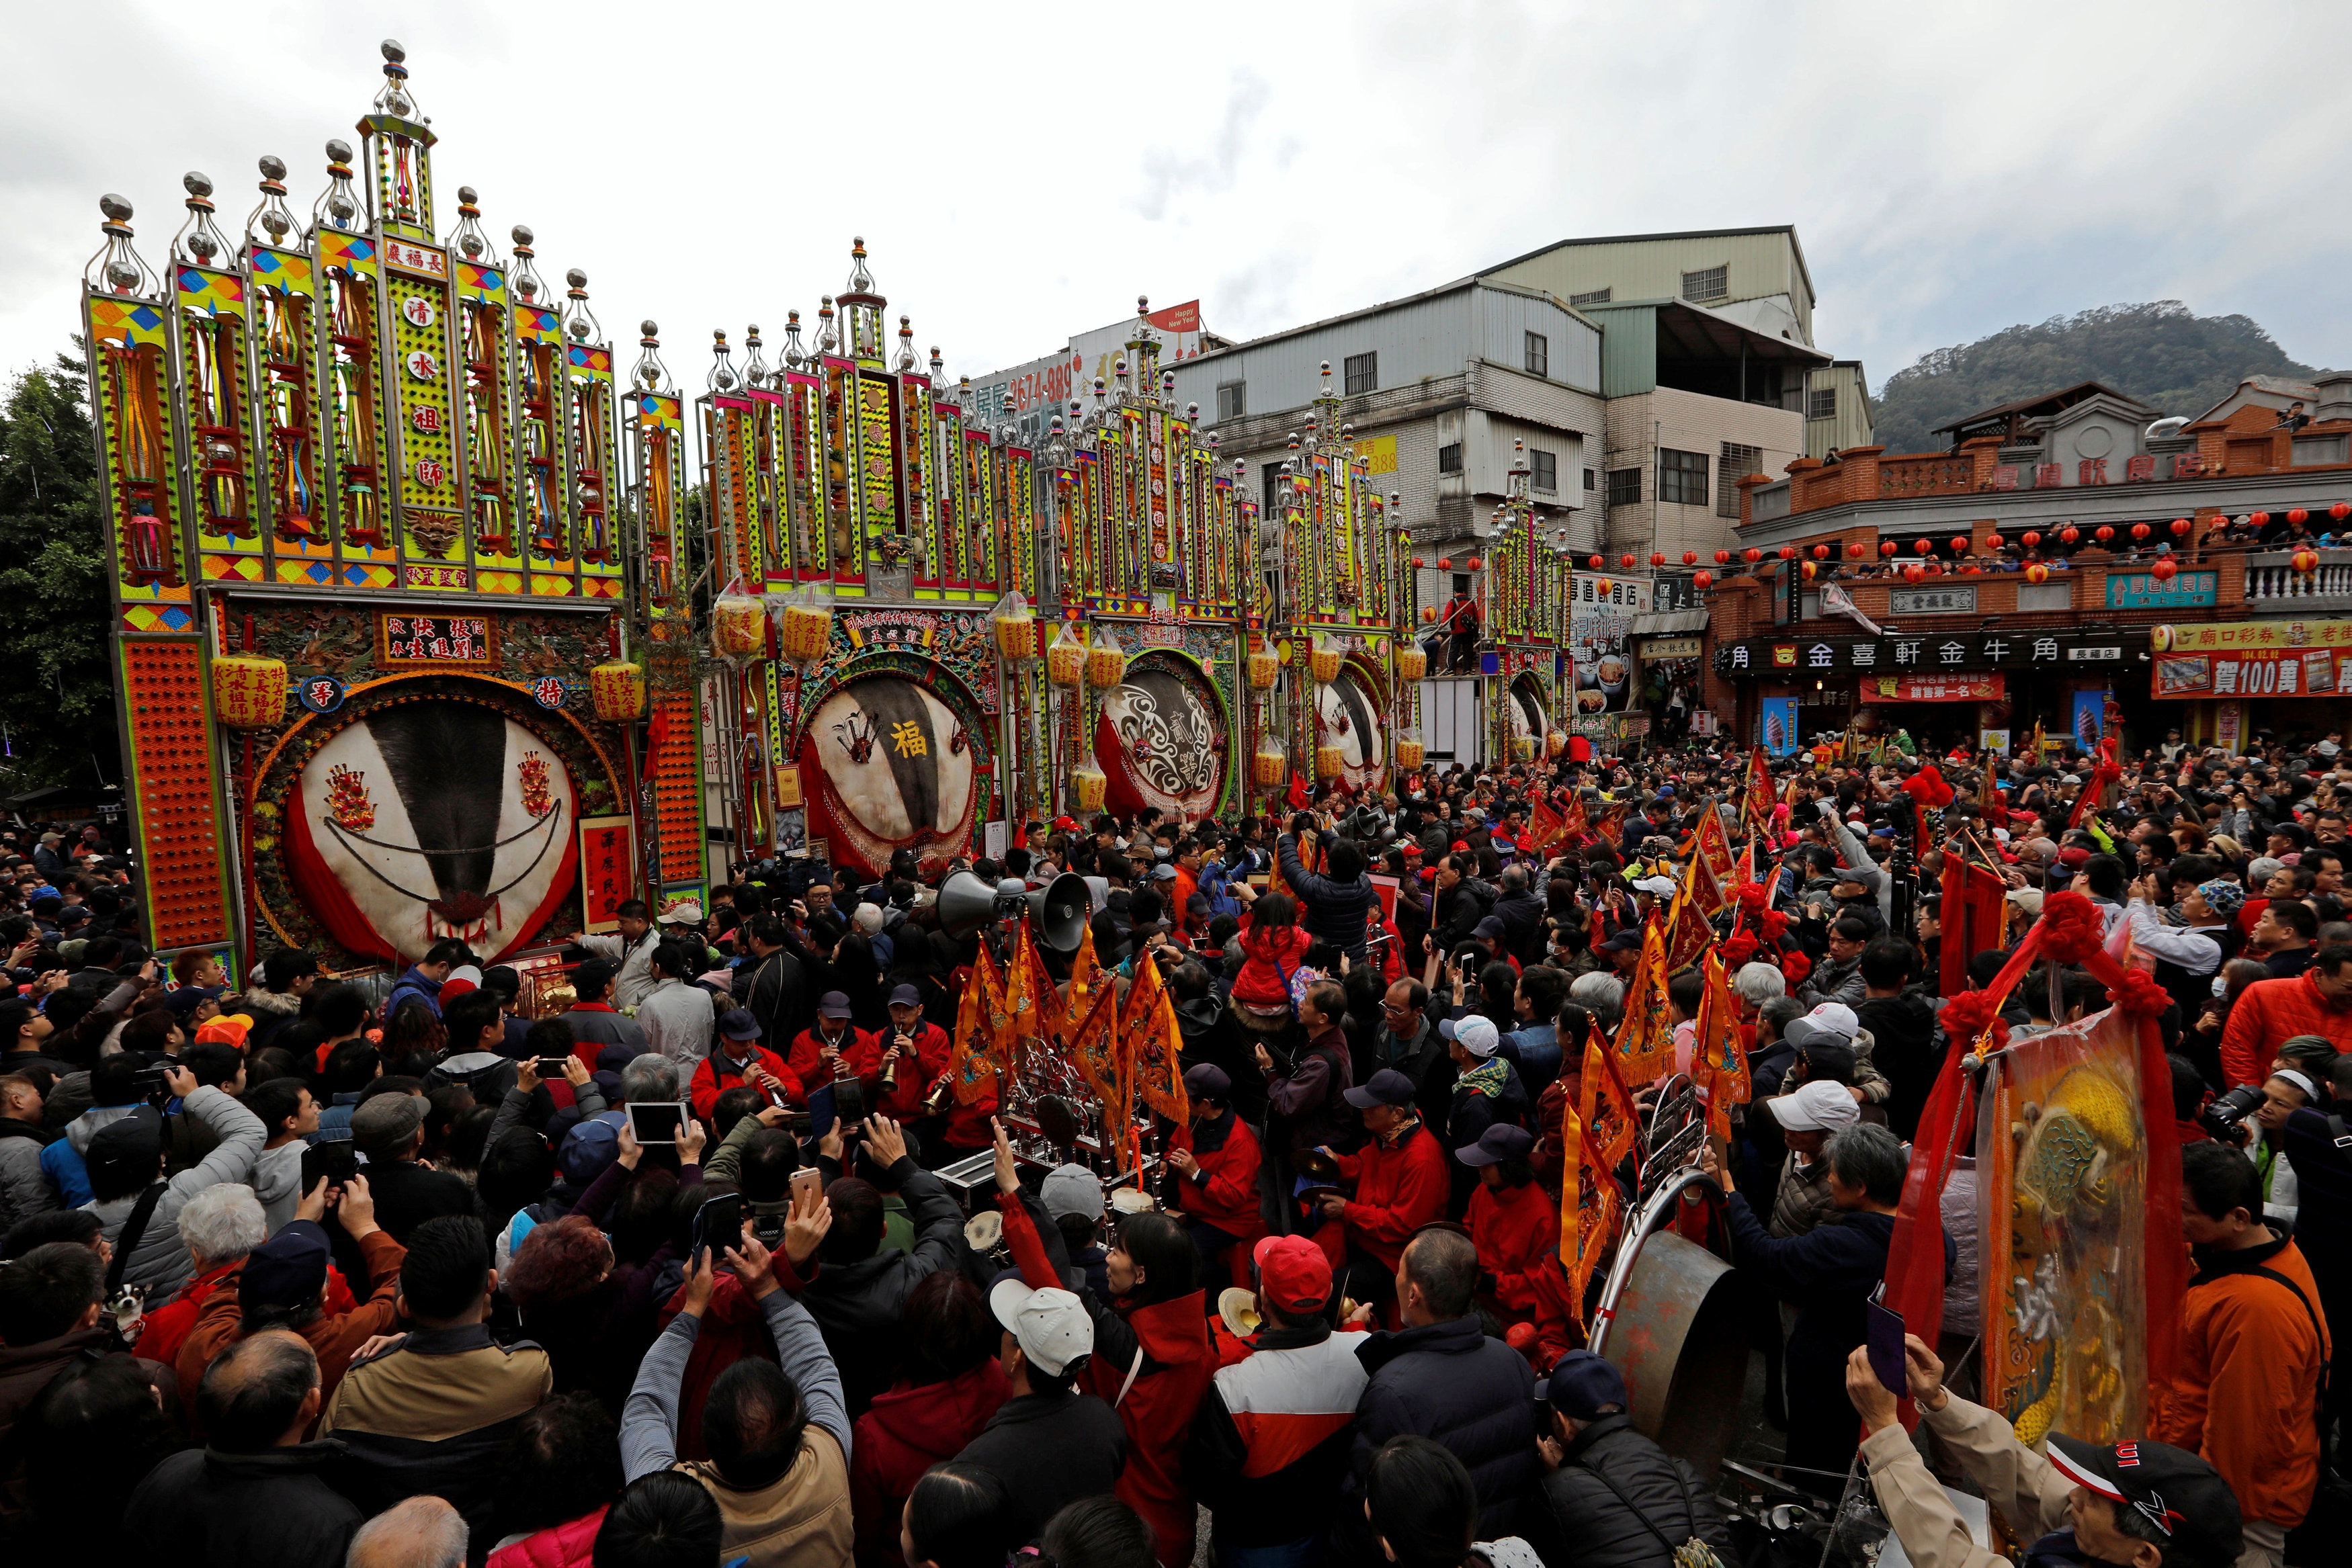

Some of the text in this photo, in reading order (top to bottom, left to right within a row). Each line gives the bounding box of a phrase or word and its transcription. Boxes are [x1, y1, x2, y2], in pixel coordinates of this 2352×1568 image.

[1168, 316, 1196, 329] New Year
[1175, 308, 1194, 318] Happy
[408, 300, 446, 489] 清水祖師
[1368, 452, 1396, 474] 388
[1992, 452, 2205, 491] 厚道飲食店
[1152, 449, 1165, 556] 清水祖師
[1570, 578, 1636, 605] 厚道食店
[2130, 574, 2216, 595] 厚道飲食店
[2138, 595, 2205, 605] 請上二樓
[1149, 605, 1189, 625] 正爐主
[2199, 627, 2275, 646] 廟口彩券
[1808, 638, 2058, 667] 金喜軒金牛角
[2076, 649, 2115, 660] 長福店
[2242, 650, 2280, 660] 104.02.02
[1876, 676, 1899, 699] 賀
[2213, 660, 2300, 695] 賀100萬
[310, 681, 334, 707] 等
[536, 679, 563, 705] 特
[1910, 685, 1970, 699] 銷售第一名
[890, 720, 928, 758] 福
